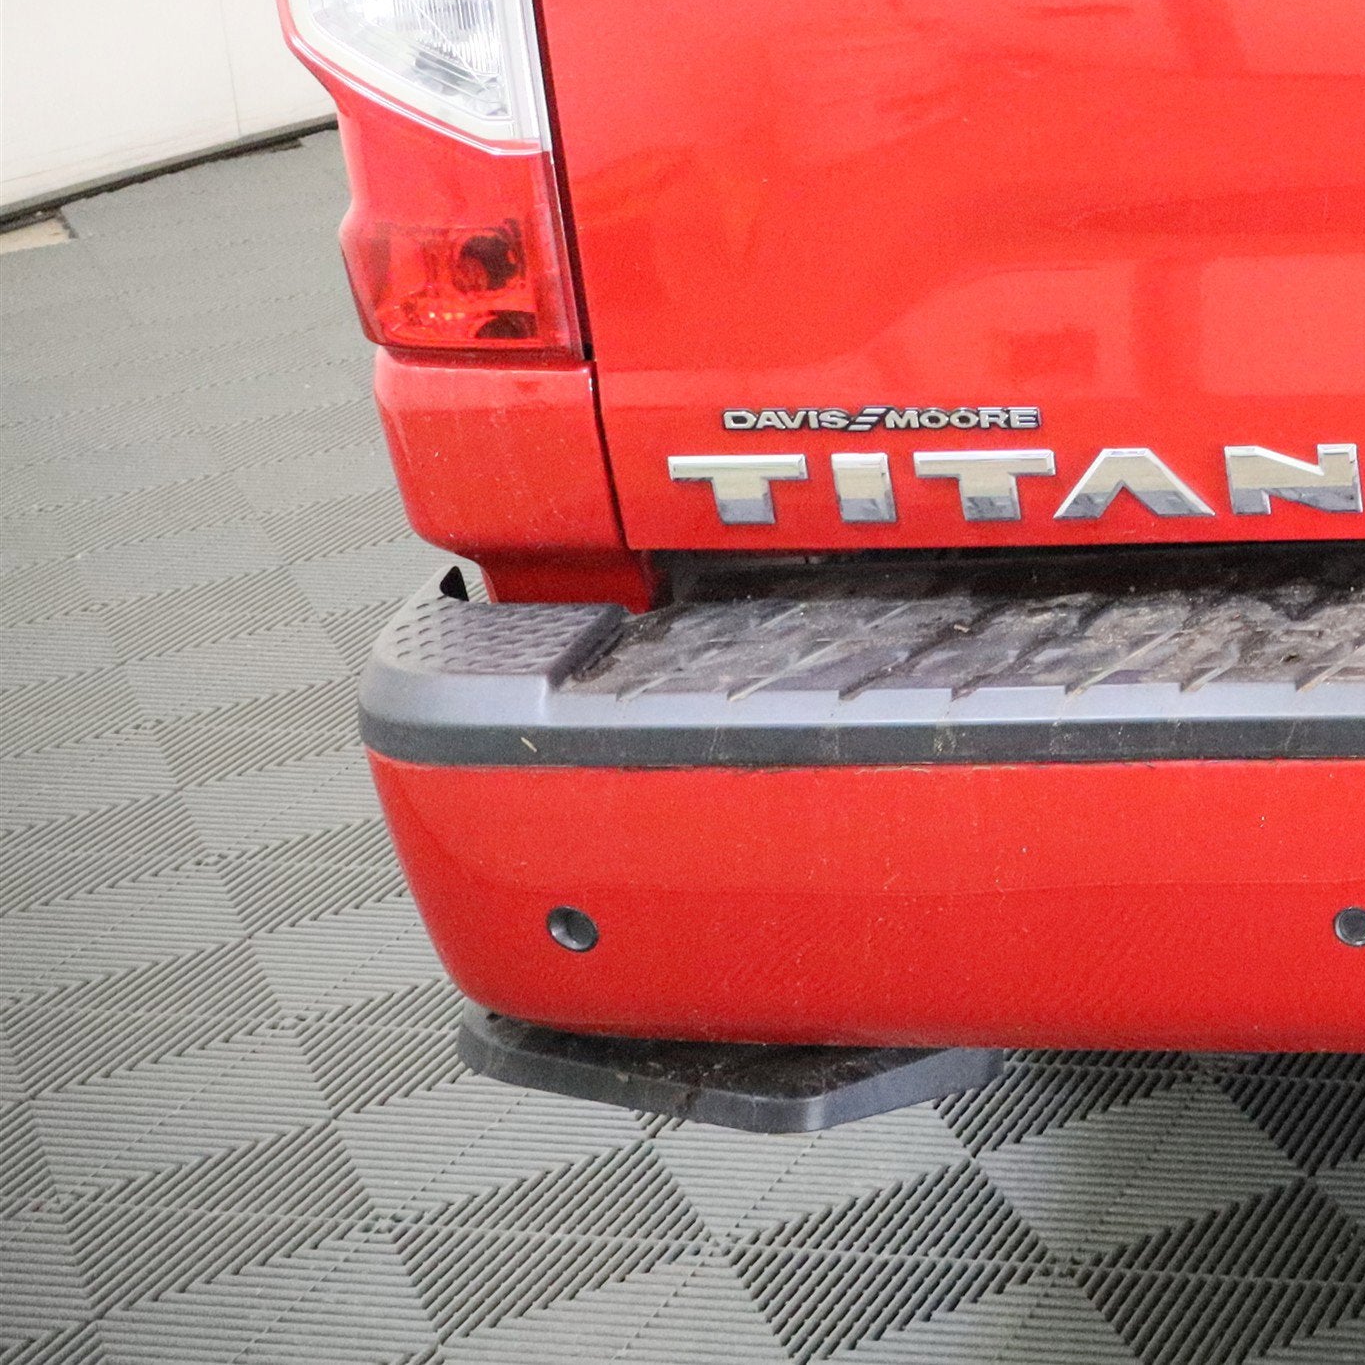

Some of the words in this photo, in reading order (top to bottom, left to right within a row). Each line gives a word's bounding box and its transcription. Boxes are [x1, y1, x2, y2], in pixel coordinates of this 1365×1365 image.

[722, 407, 850, 430] DAVIS
[883, 405, 1042, 429] MOORE
[667, 443, 1364, 525] TITAN
